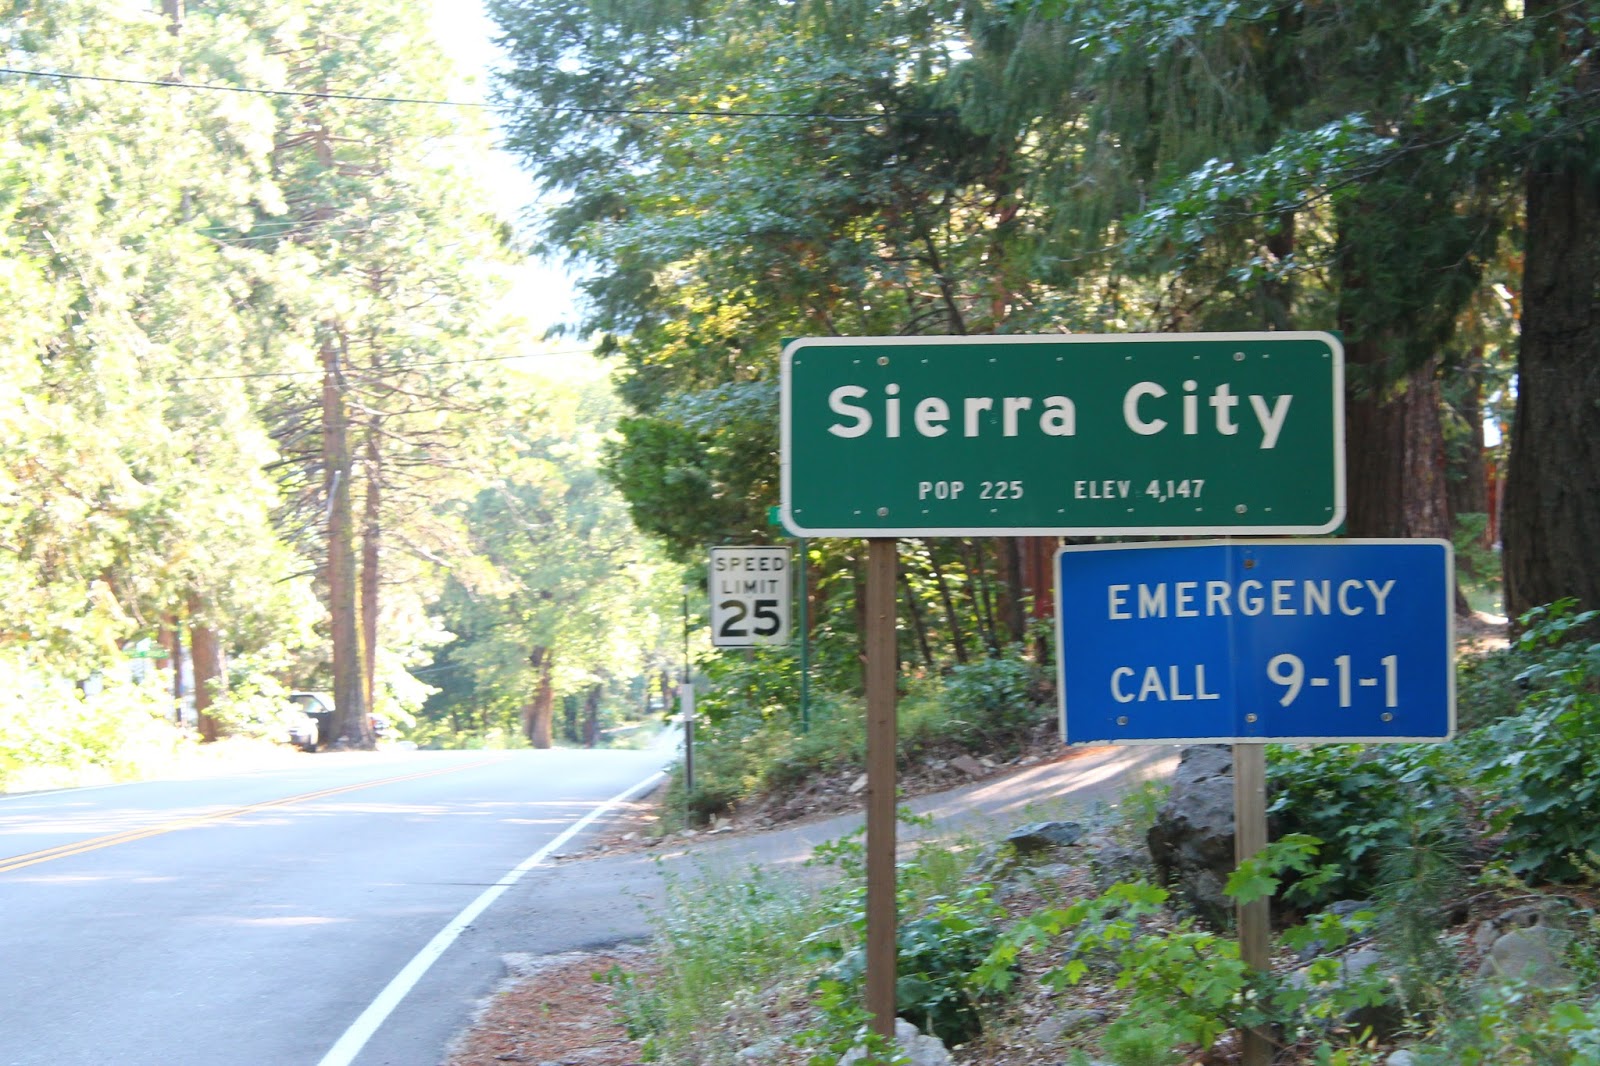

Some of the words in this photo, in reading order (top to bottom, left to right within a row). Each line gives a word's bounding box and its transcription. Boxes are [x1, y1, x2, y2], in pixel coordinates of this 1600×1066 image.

[826, 382, 1077, 440] Sierra
[1121, 378, 1294, 449] City
[918, 480, 965, 500] POP
[979, 480, 1024, 500] 225
[1073, 480, 1132, 499] ELEV
[1144, 479, 1206, 503] 4,147
[714, 556, 785, 572] SPEED
[721, 579, 779, 595] LIMIT
[1107, 579, 1397, 620] EMERGENCY
[718, 599, 781, 638] 25
[1110, 664, 1220, 703] CALL
[1266, 653, 1399, 708] 9-1-1
